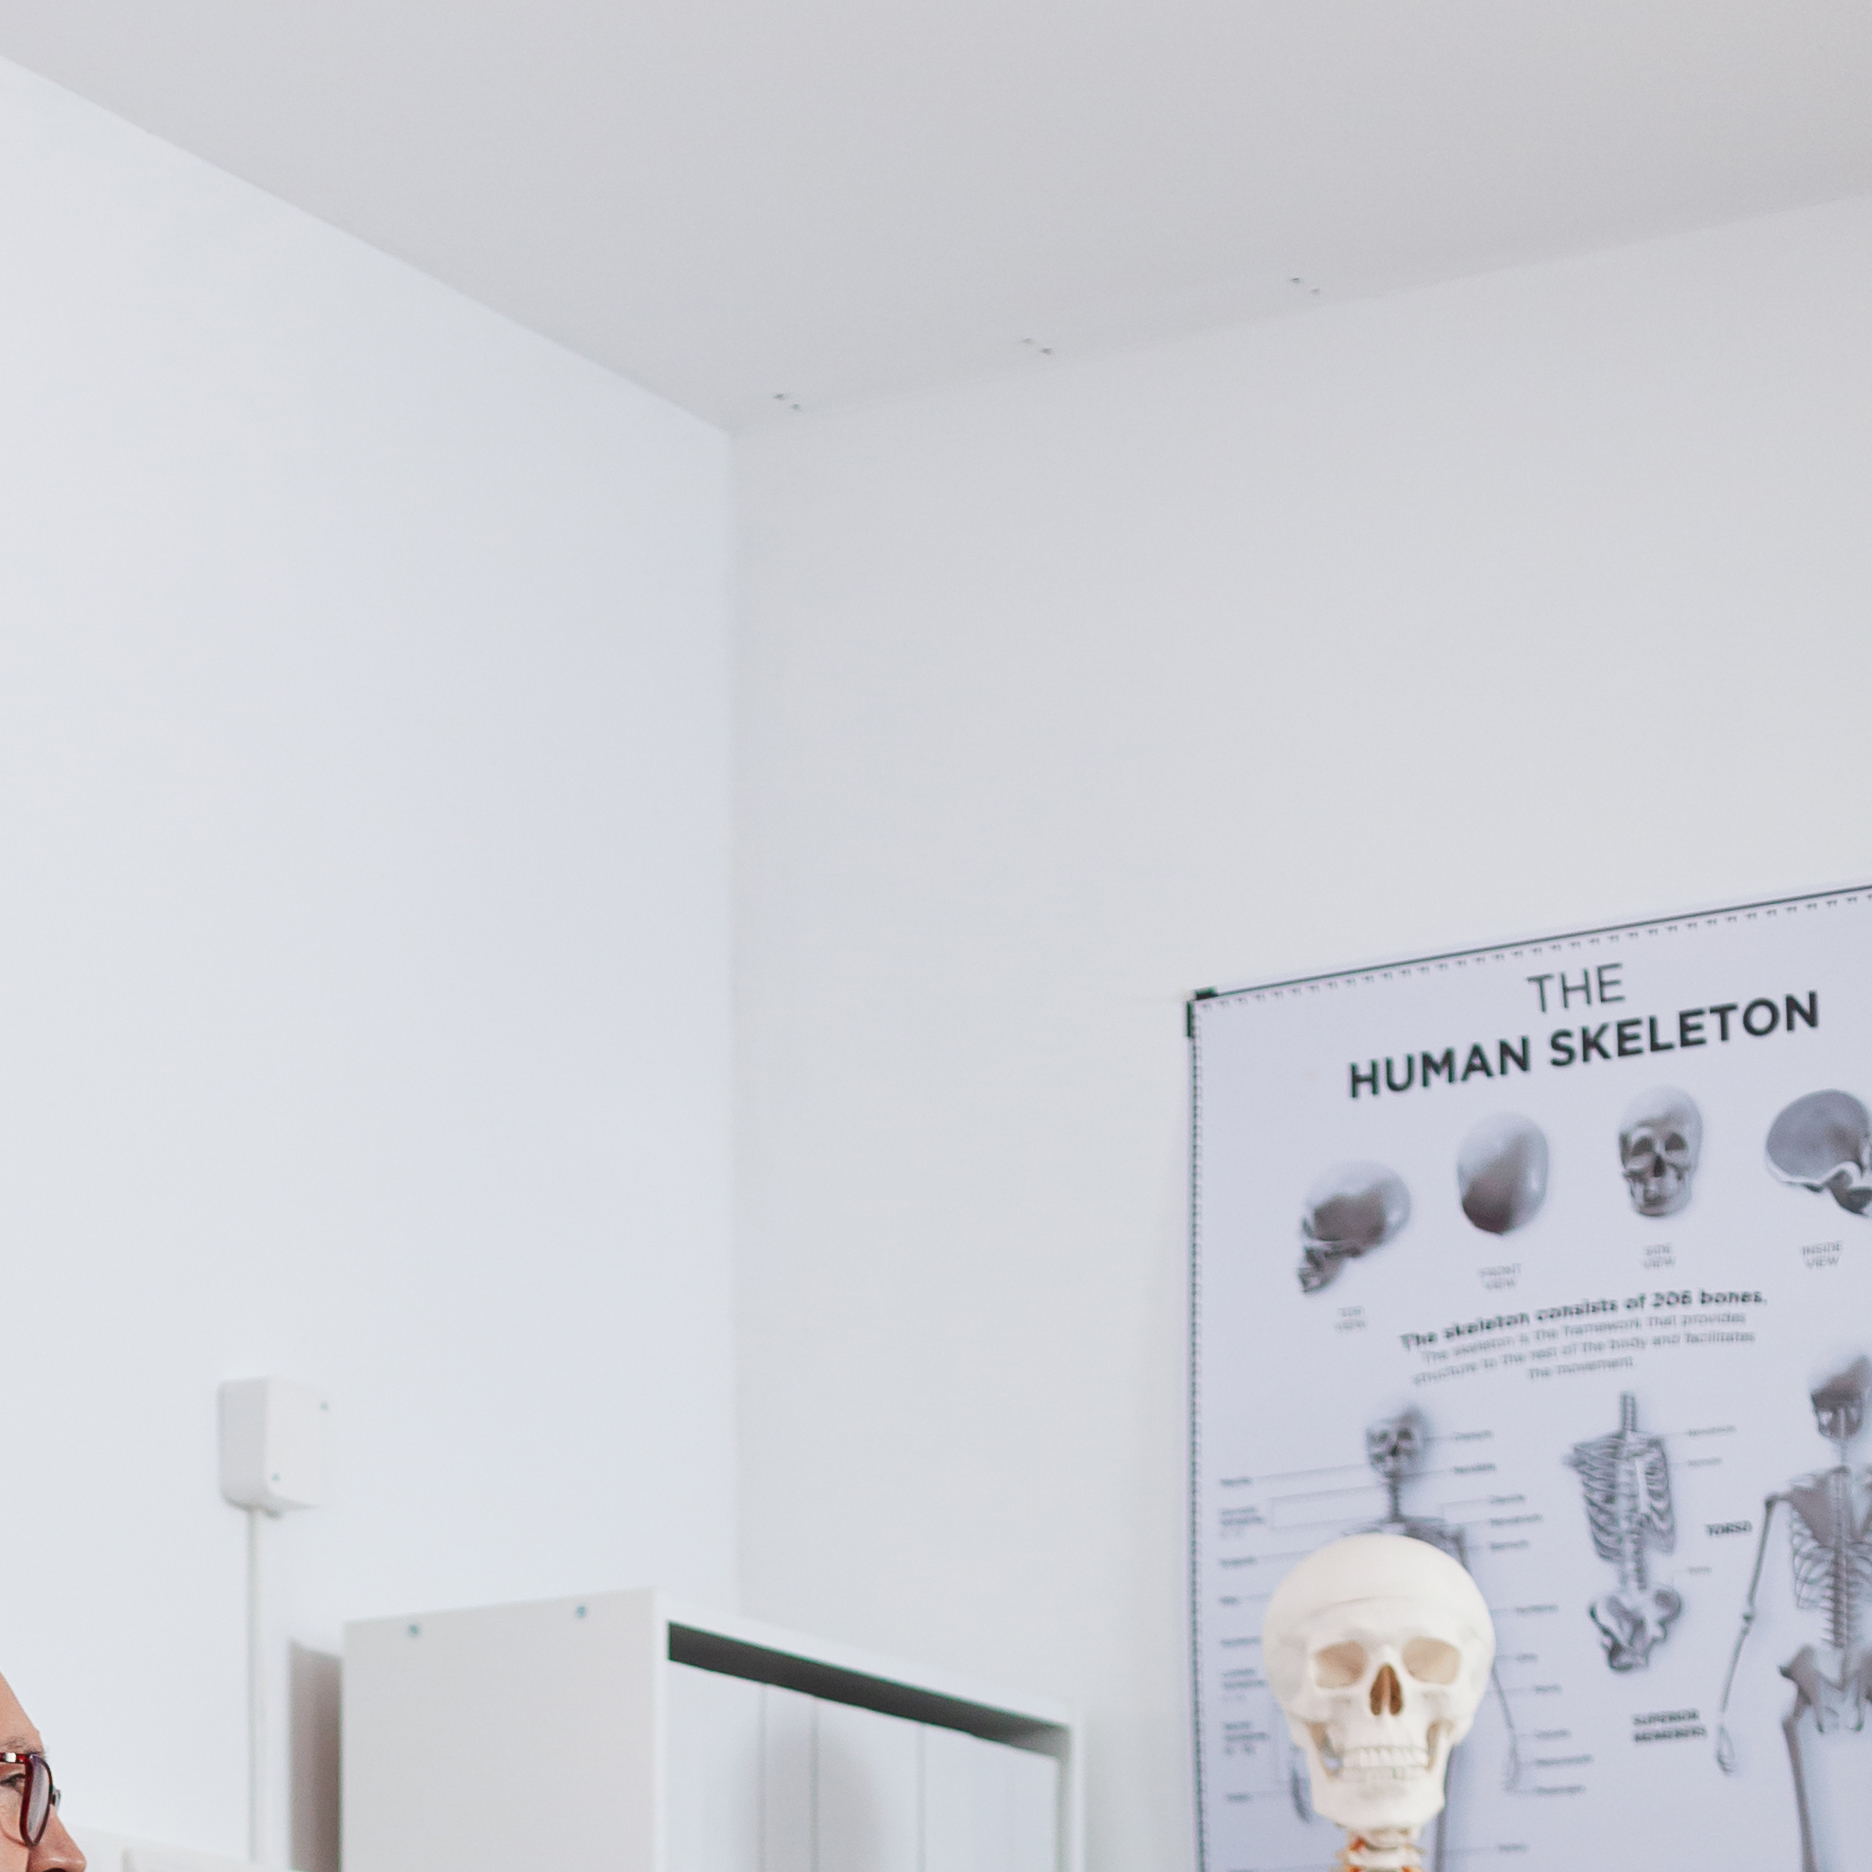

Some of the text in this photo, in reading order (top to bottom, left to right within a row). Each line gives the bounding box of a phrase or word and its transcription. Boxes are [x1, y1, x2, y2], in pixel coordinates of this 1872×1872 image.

[1527, 963, 1626, 1014] THE
[1349, 990, 1820, 1100] HUMAN SKELETON
[1803, 1254, 1841, 1270] VIEW
[1399, 1331, 1438, 1350] The
[1443, 1312, 1530, 1339] skeleton
[1535, 1298, 1618, 1322] consists
[1624, 1291, 1646, 1310] of
[1652, 1290, 1692, 1308] 206
[1705, 1520, 1753, 1537] TORSO
[1631, 1708, 1700, 1727] SUPERIOR
[1632, 1725, 1707, 1743] MEMBERS
